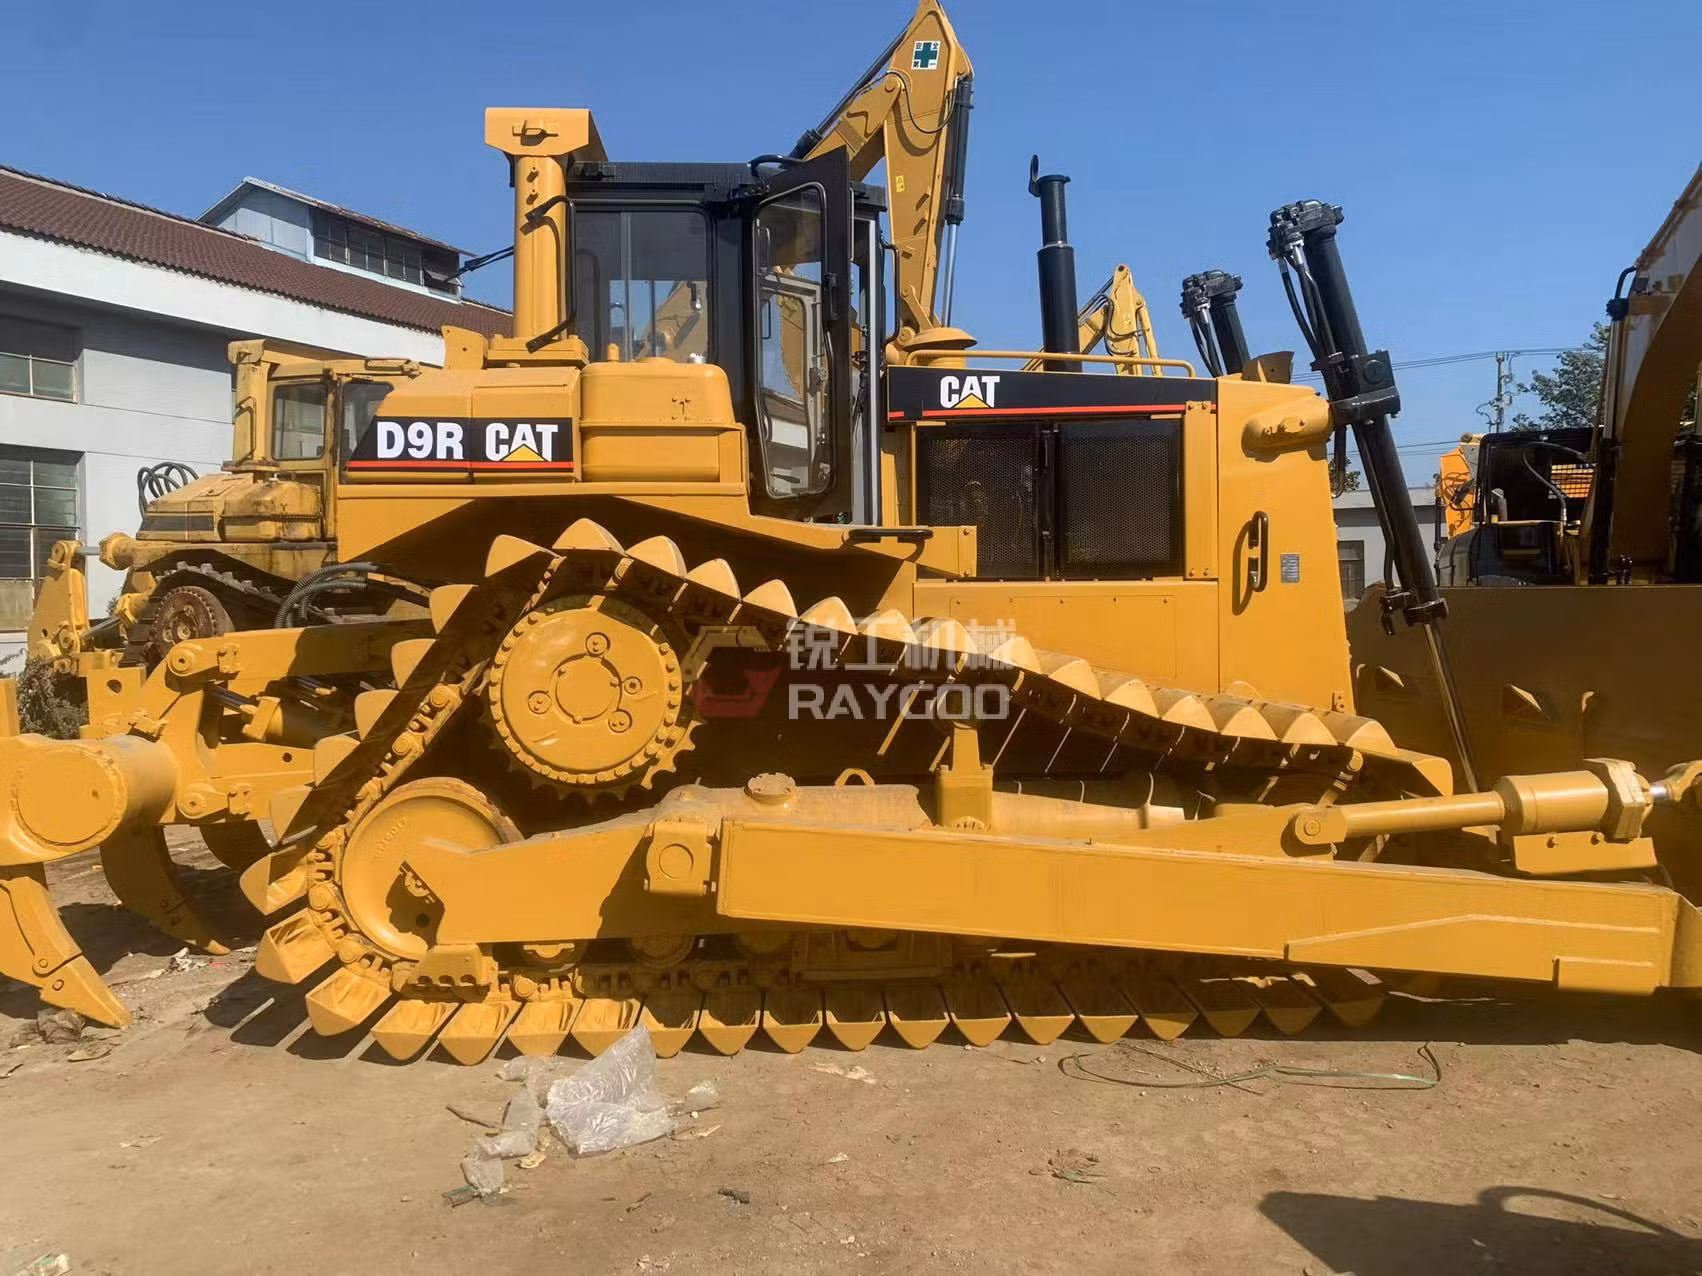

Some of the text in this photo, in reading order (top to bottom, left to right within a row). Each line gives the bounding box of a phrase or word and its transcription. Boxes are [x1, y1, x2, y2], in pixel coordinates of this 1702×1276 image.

[940, 375, 1001, 408] CAT
[377, 421, 559, 462] D9R CAT
